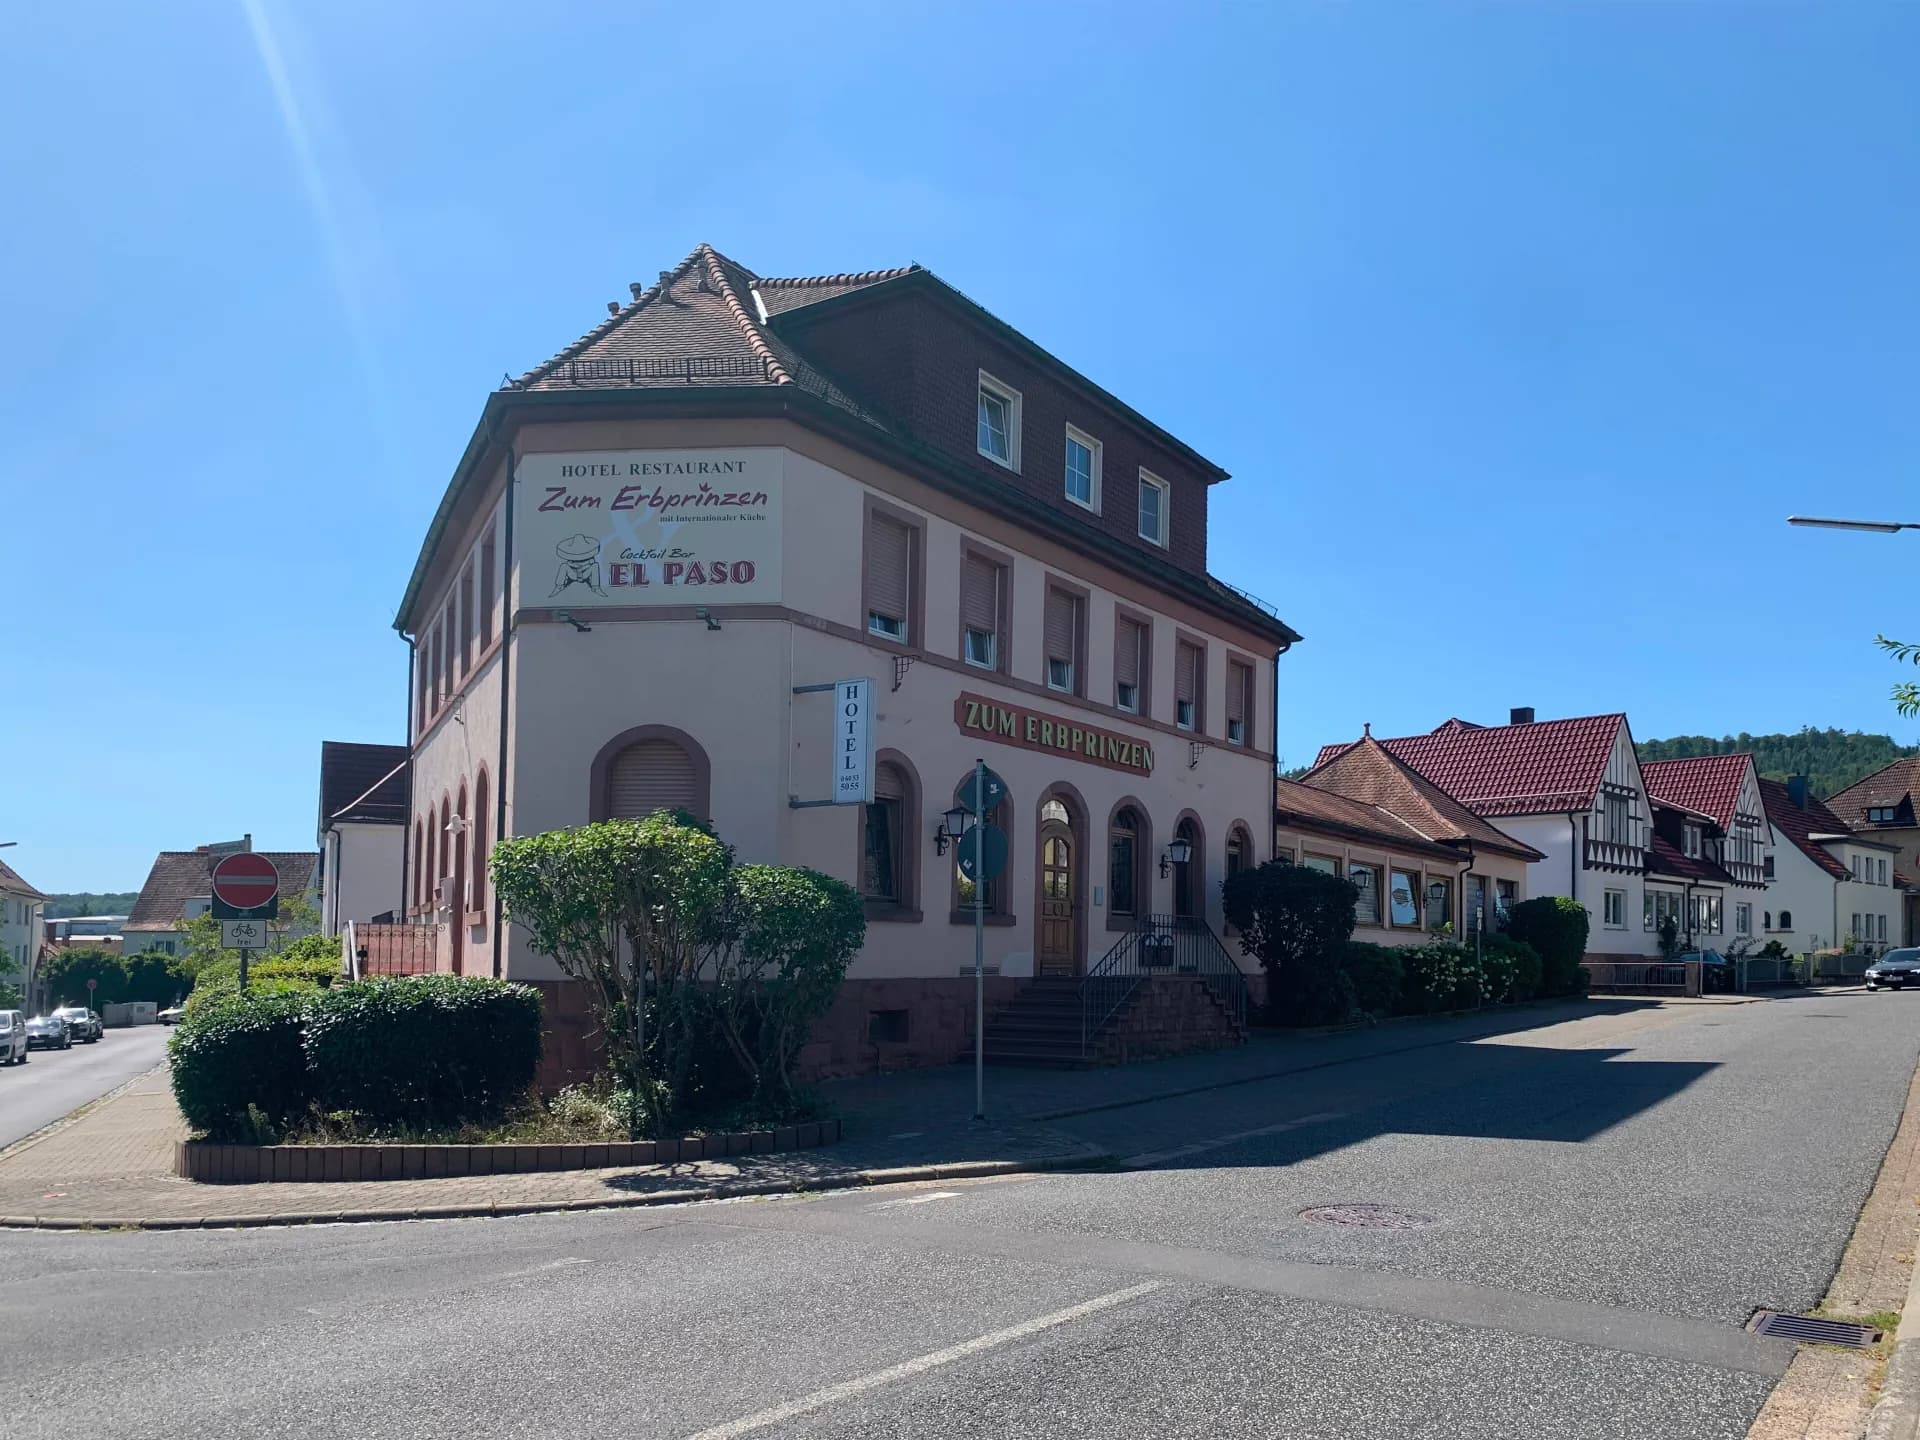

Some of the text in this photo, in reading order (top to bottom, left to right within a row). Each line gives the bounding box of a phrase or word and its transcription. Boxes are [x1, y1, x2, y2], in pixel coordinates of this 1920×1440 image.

[562, 461, 747, 477] HOTEL RESTAURANT
[537, 482, 768, 513] Zum Erbprinzen
[660, 513, 766, 523] mit Internationaler Küche
[620, 548, 696, 560] Cocktail Bar
[608, 560, 756, 588] EL PASO
[844, 685, 858, 770] HOTEL
[965, 700, 1154, 771] ZUM ERBPRINZEN
